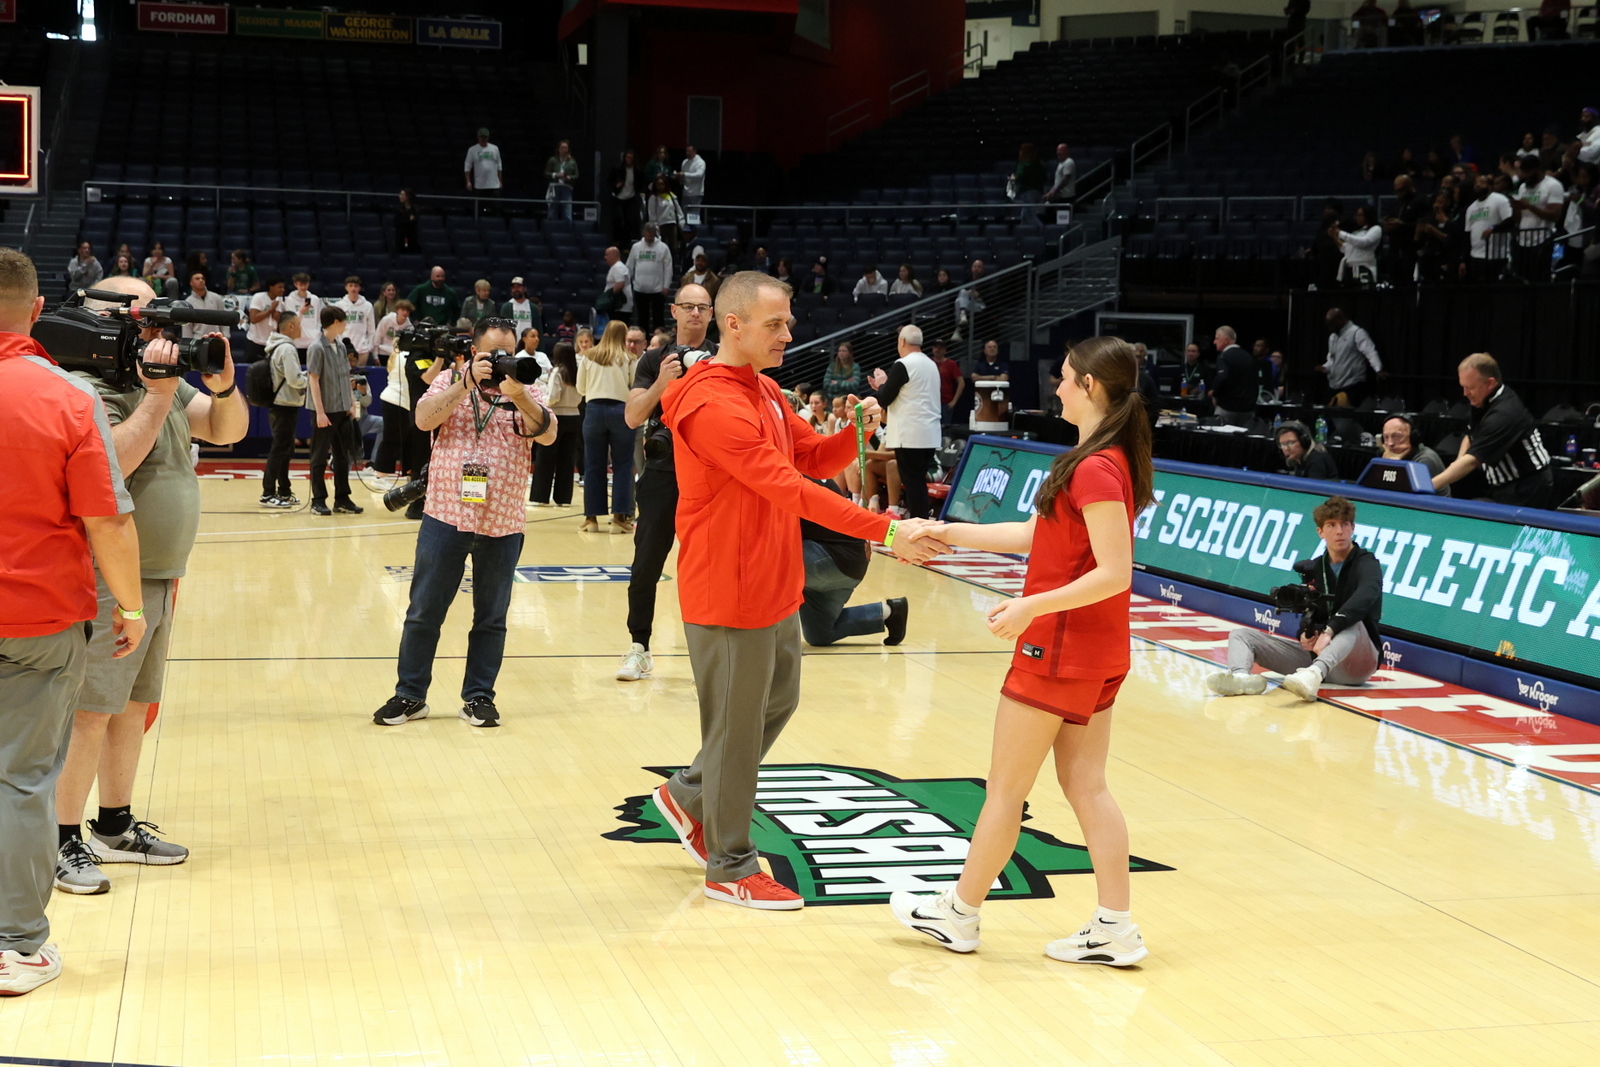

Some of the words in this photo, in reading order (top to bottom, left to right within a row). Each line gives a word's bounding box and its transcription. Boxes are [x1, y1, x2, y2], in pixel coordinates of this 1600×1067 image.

[150, 11, 216, 26] FORDHAM
[238, 16, 280, 27] GEORGE
[284, 18, 322, 29] MASON
[344, 17, 394, 29] GEORGE
[329, 27, 409, 40] WASHINGTON
[428, 25, 447, 39] LA
[450, 27, 490, 41] SALLE
[971, 467, 1010, 501] OHSAA
[1382, 469, 1397, 482] POSS
[1158, 493, 1304, 572] SCHOOL
[1311, 523, 1570, 628] THLETIC
[1261, 609, 1281, 632] Kroger
[1382, 641, 1402, 667] roger
[1529, 680, 1559, 711] Kroger
[755, 769, 1004, 895] OHSAA
